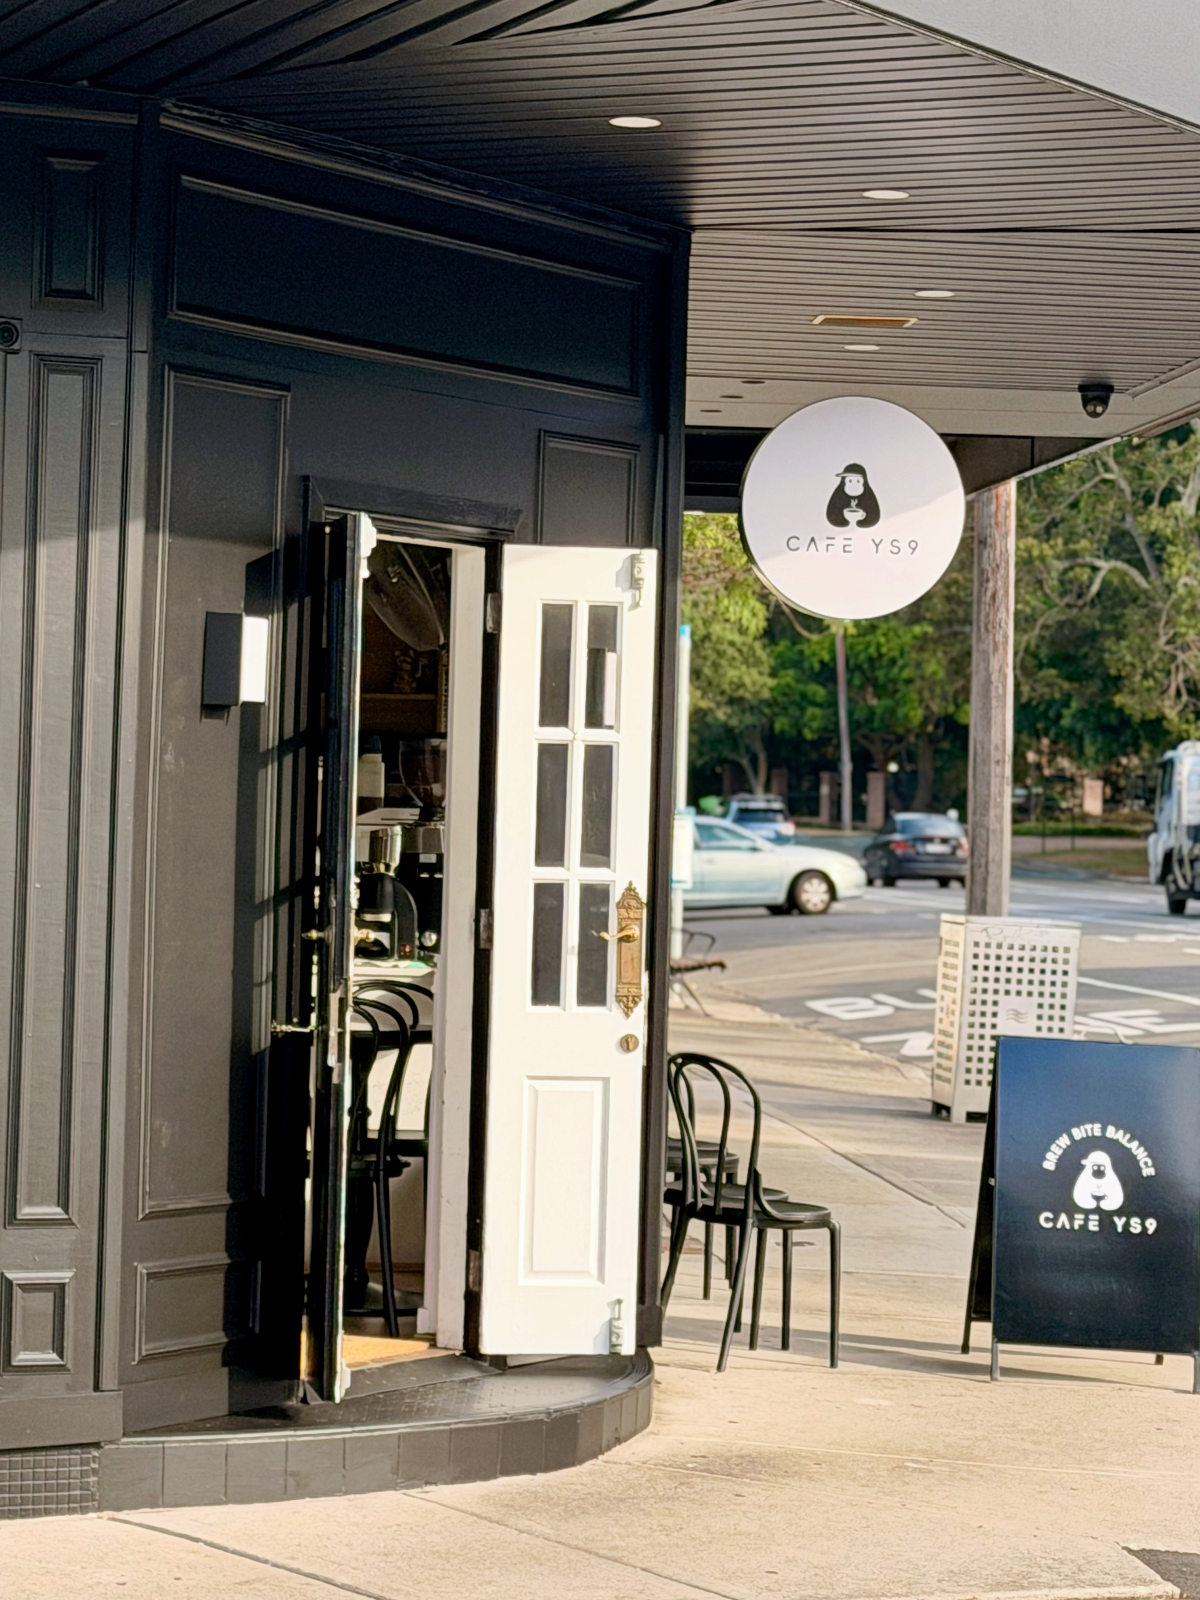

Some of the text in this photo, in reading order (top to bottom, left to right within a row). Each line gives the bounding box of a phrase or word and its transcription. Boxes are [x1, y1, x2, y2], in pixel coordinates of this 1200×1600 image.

[786, 535, 919, 555] CAFE YS9
[1042, 1122, 1156, 1178] BREW BITE BALANCE
[1039, 1211, 1157, 1235] CAFE YS9
